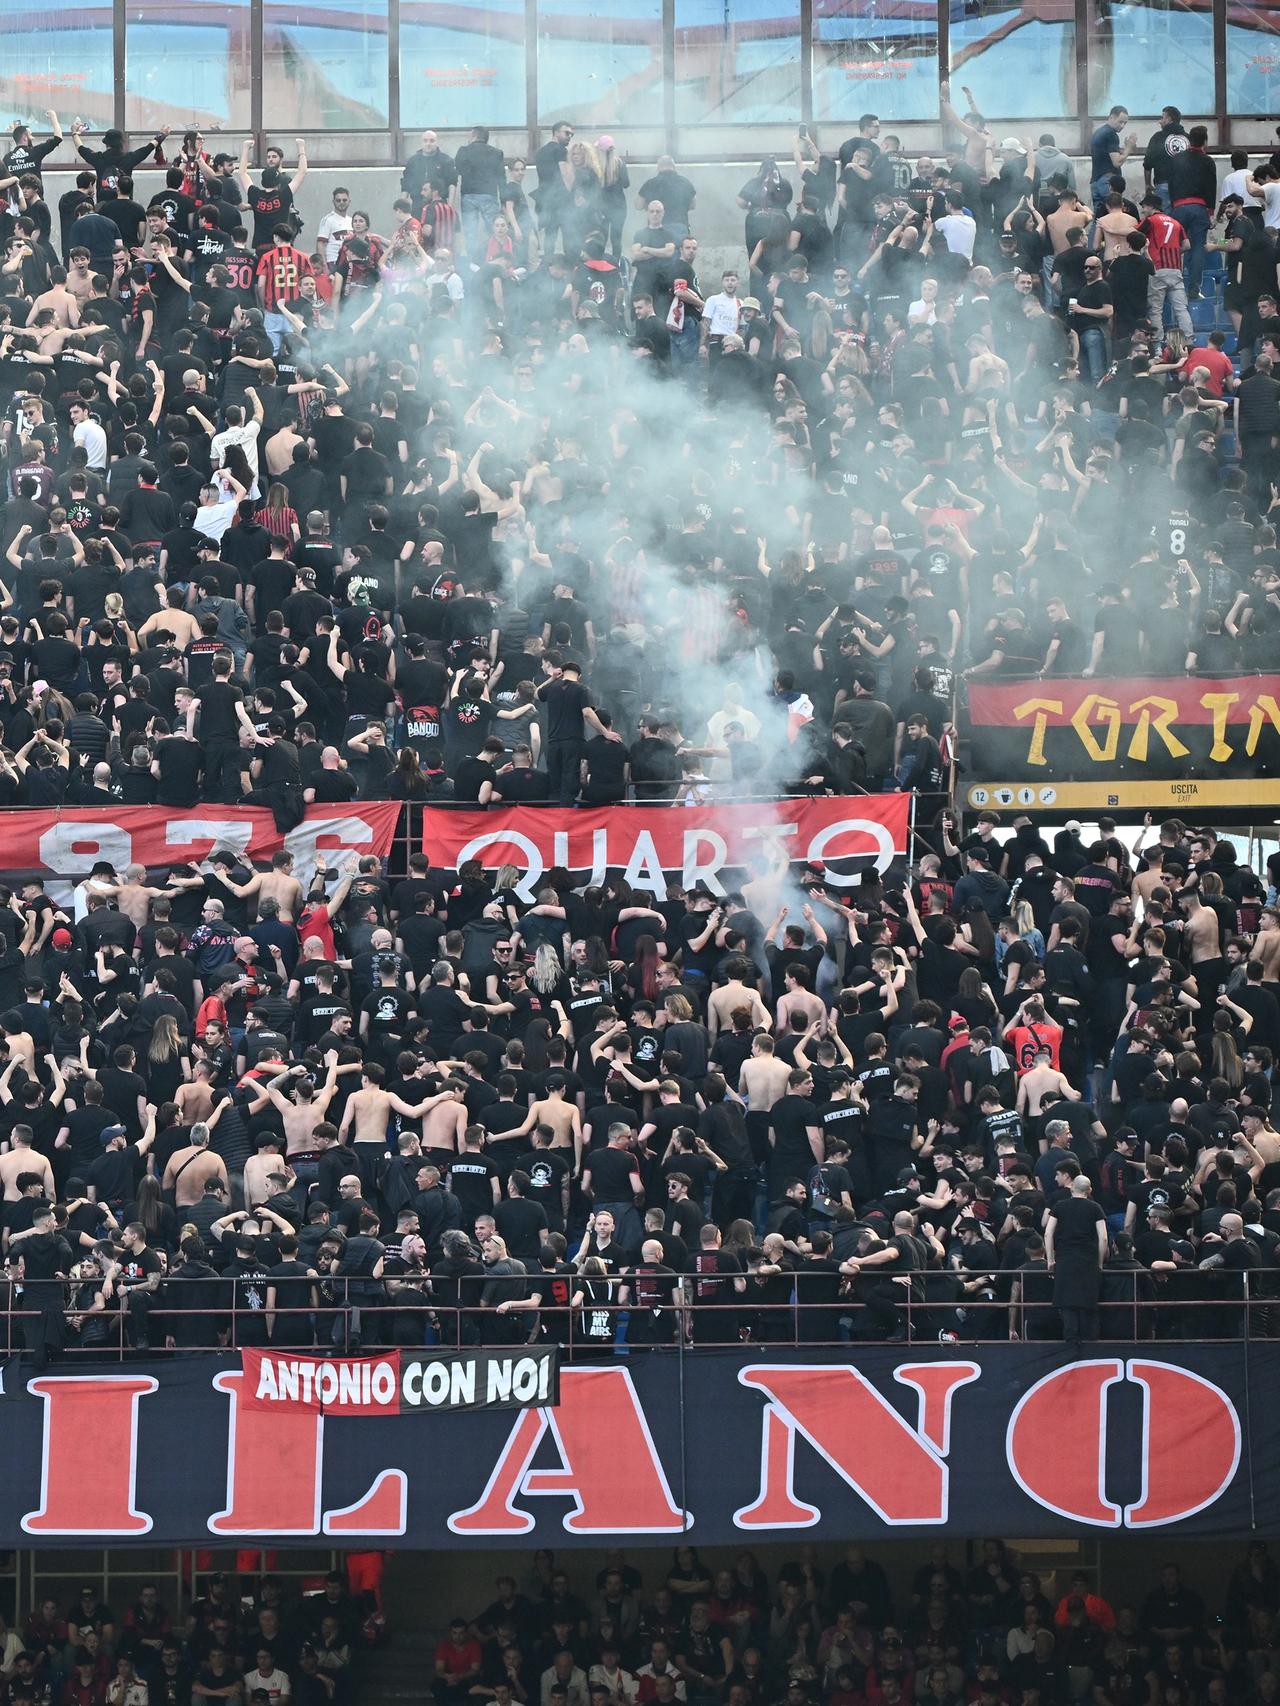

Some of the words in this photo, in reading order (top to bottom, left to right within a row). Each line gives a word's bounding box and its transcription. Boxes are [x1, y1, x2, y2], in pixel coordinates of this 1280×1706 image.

[8, 162, 36, 173] Emirates
[1163, 222, 1174, 244] 7
[226, 265, 253, 289] 30
[275, 265, 298, 287] 22
[1170, 529, 1186, 555] 8
[976, 791, 985, 802] 12
[1171, 784, 1198, 794] USCITA
[1177, 795, 1191, 803] EXIT
[457, 818, 895, 904] QUARTO
[593, 1317, 607, 1326] MY
[591, 1326, 613, 1336] AIRS.
[255, 1357, 397, 1406] ANTONIO
[402, 1361, 476, 1406] CON
[486, 1355, 550, 1402] NOI
